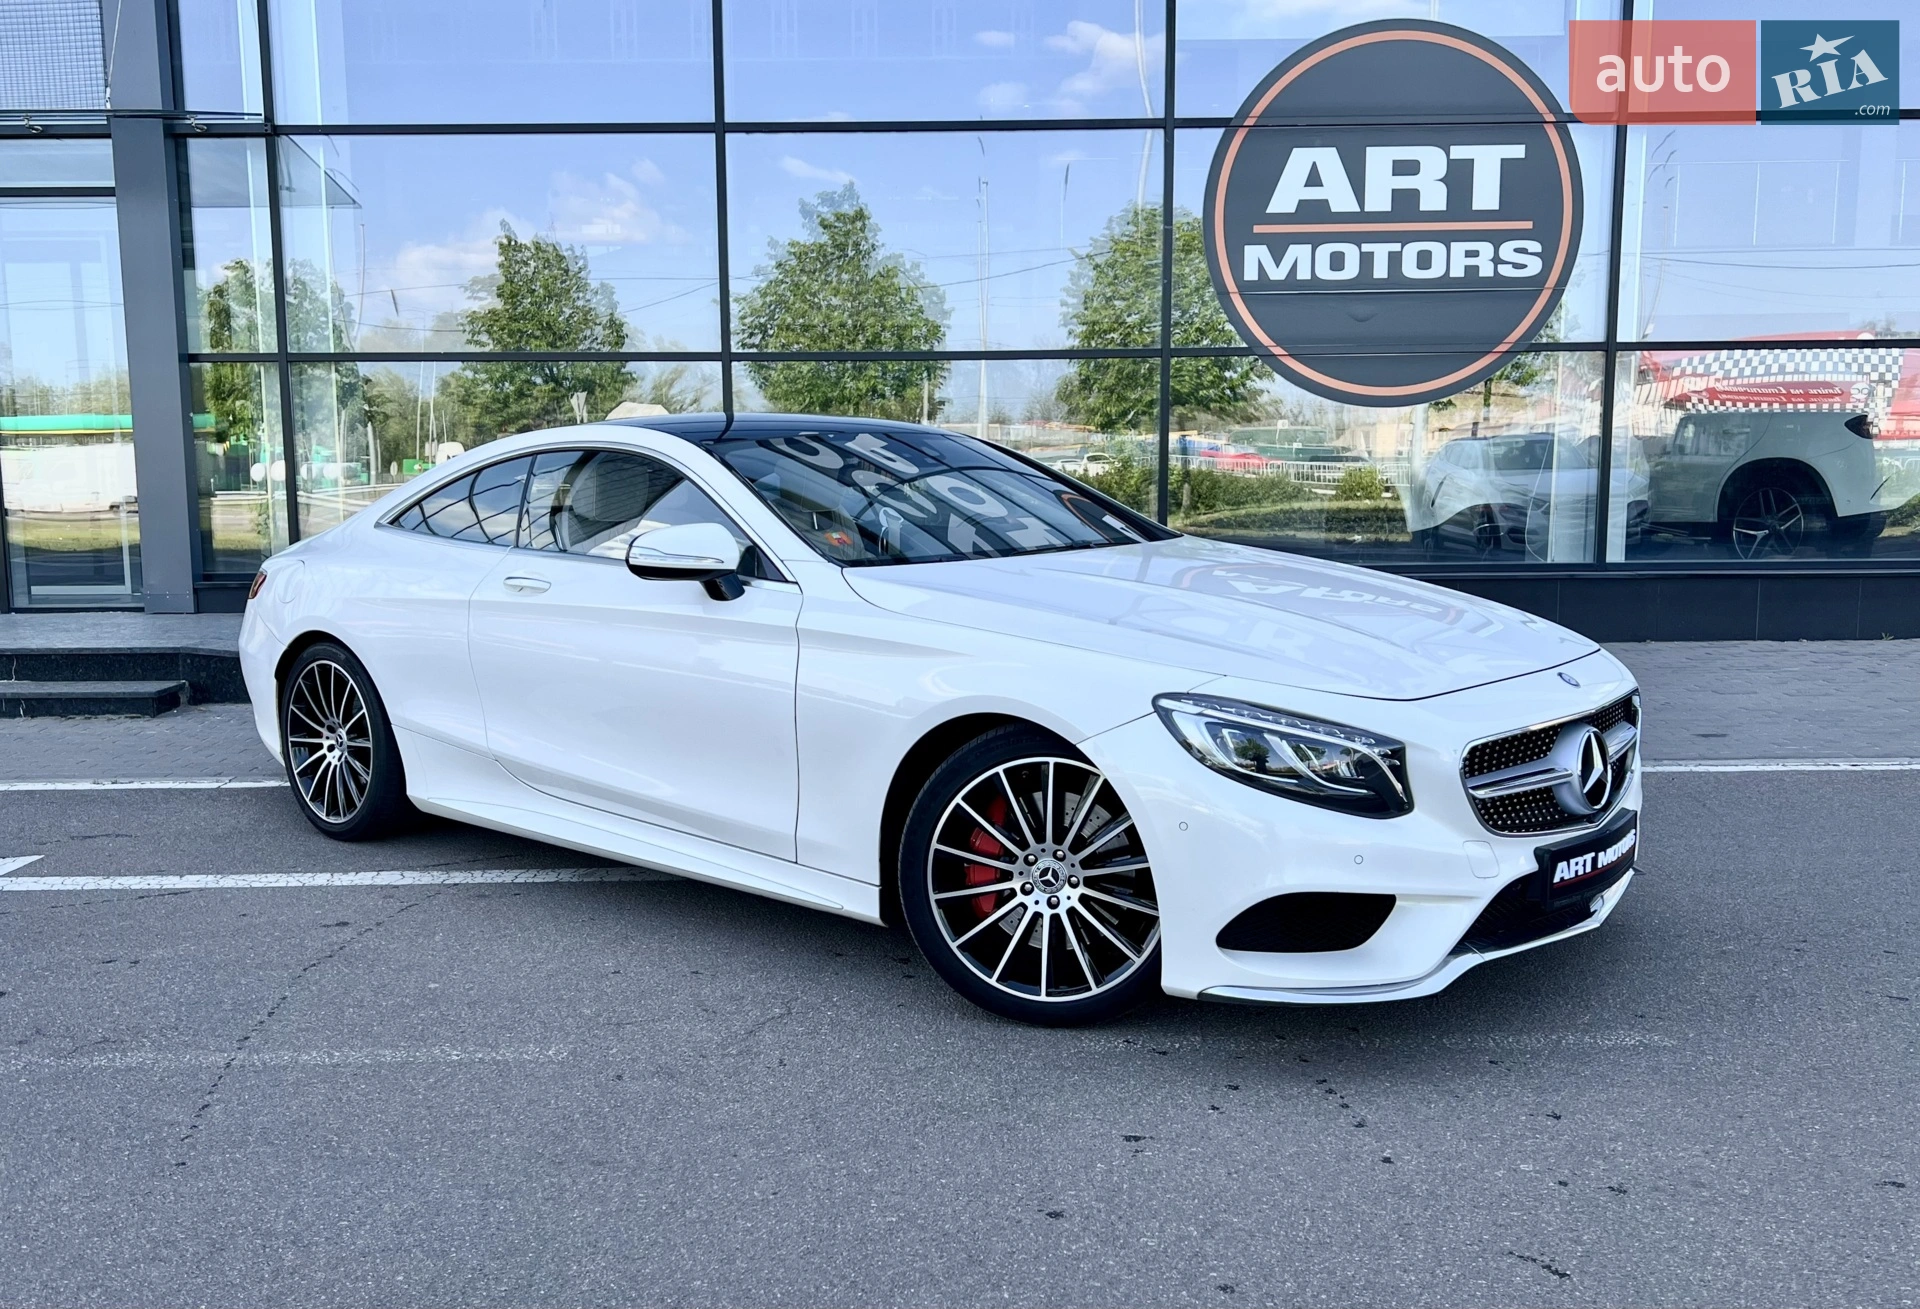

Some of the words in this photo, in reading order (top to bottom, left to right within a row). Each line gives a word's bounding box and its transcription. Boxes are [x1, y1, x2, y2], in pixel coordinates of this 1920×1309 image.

[1265, 144, 1526, 214] ART
[1243, 239, 1543, 281] MOTORS
[1553, 852, 1596, 883] ART
